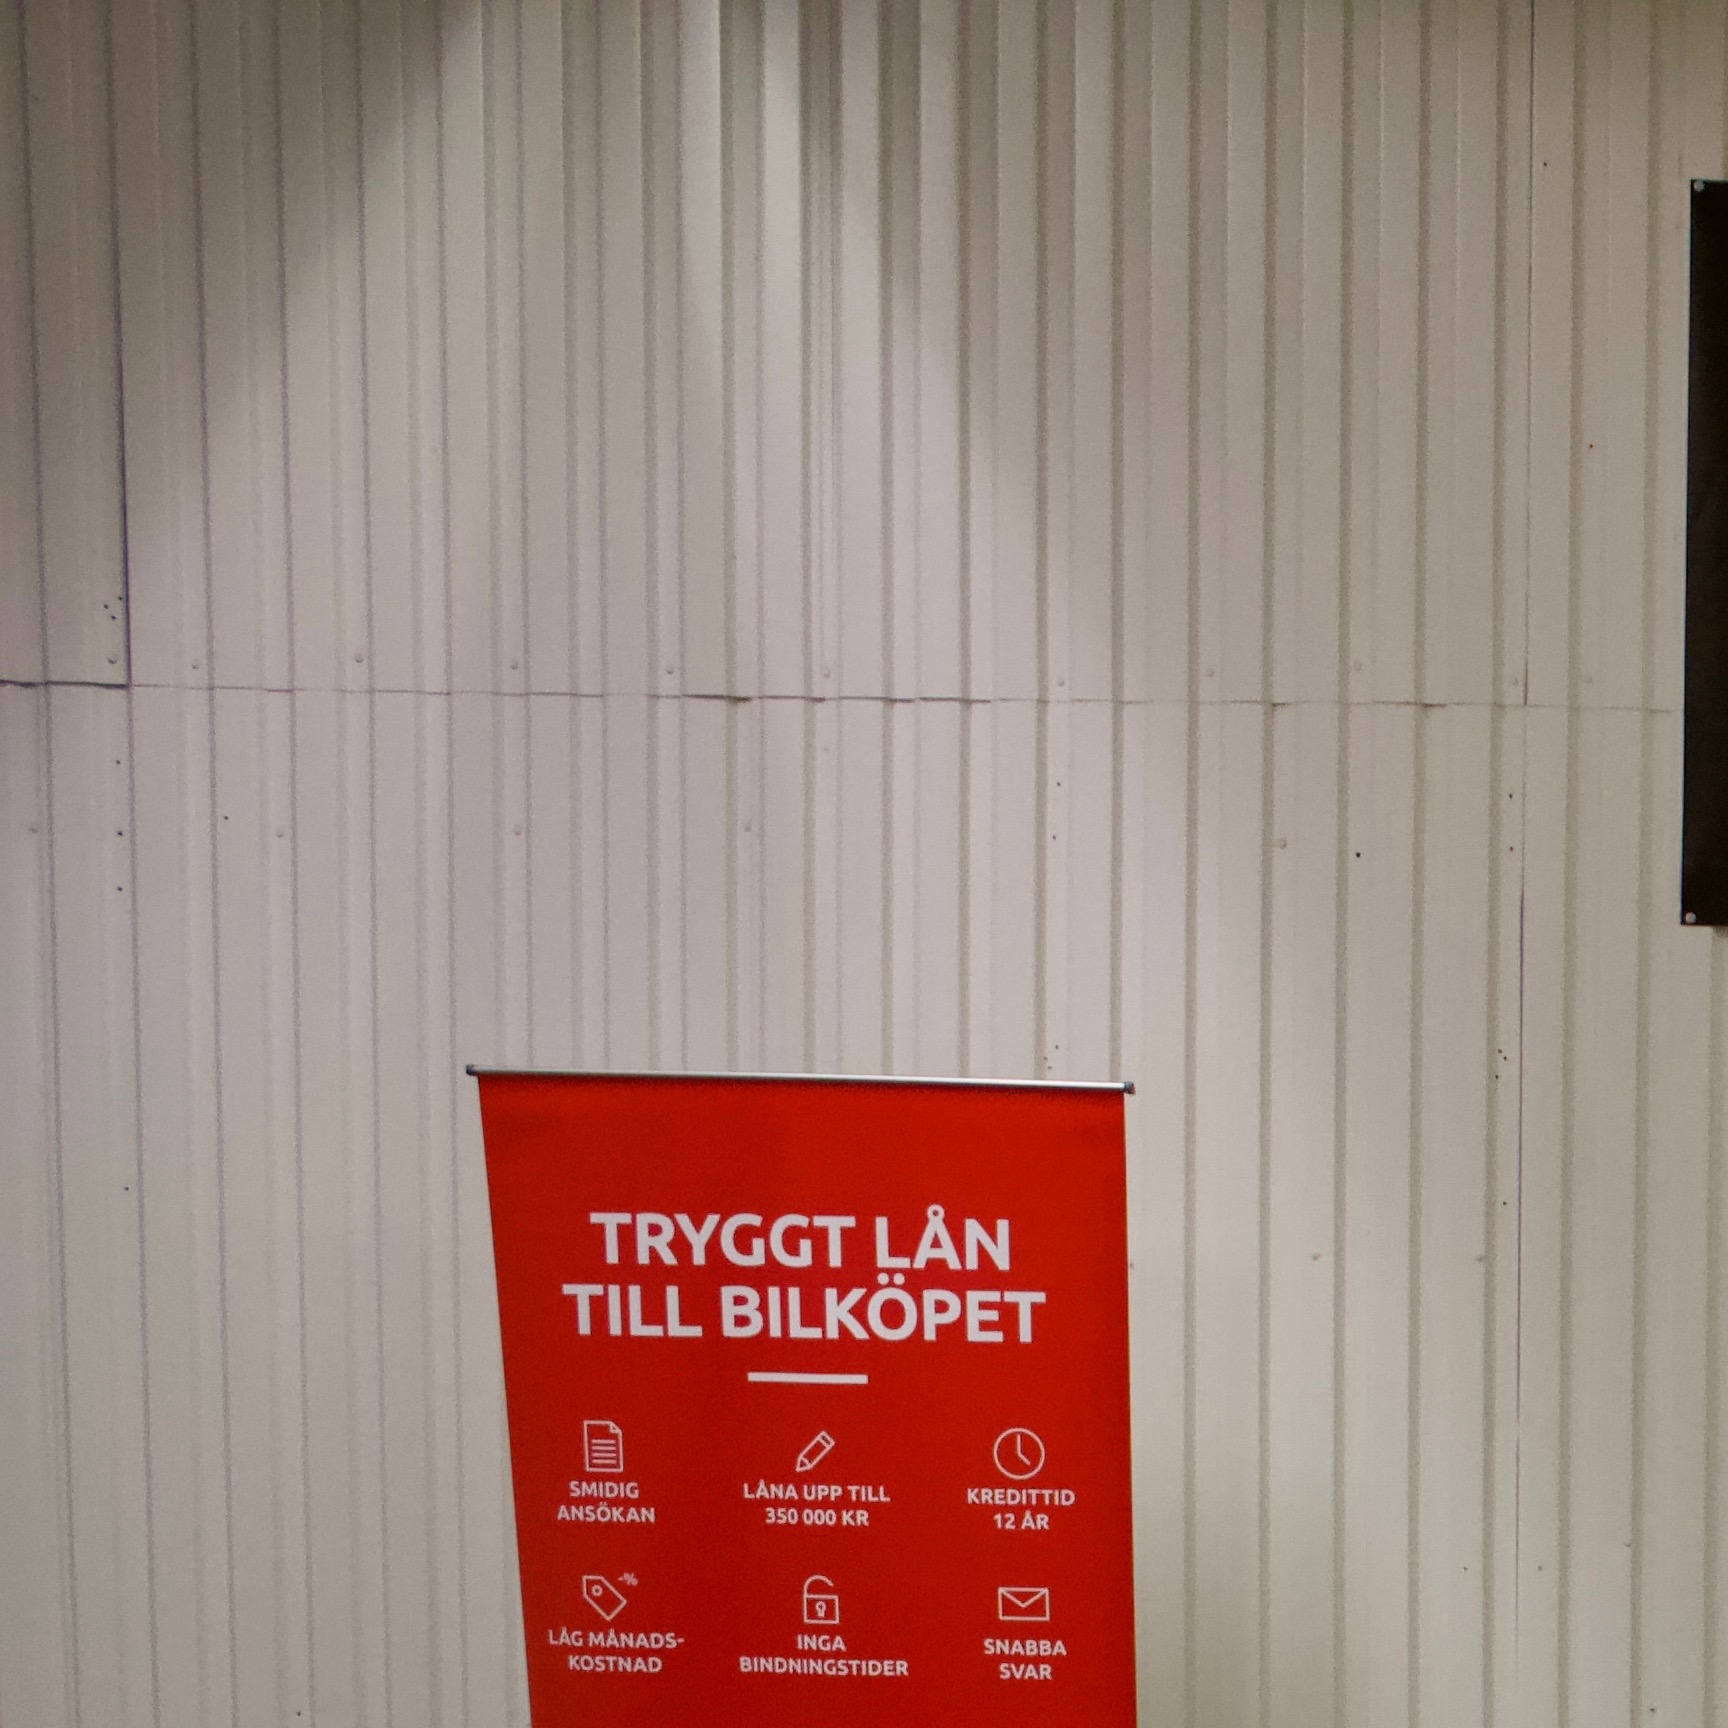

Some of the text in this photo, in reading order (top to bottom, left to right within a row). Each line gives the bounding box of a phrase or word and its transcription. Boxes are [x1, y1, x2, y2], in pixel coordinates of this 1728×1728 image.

[589, 1203, 1011, 1272] TRYGGT LÅN
[561, 1272, 1047, 1343] TILL BILKÖPET
[569, 1480, 640, 1499] SMIDIG
[743, 1479, 891, 1503] LÅNA UPP TILL
[967, 1487, 1076, 1507] KREDITTID
[557, 1501, 656, 1524] ANSÖKAN
[765, 1506, 869, 1527] 350 000 KR
[993, 1509, 1050, 1531] 12 ÅR
[548, 1628, 685, 1649] LÅG MÅNADS-
[796, 1633, 847, 1652] INGA
[983, 1638, 1067, 1657] SNABBA
[568, 1654, 663, 1673] KOSTNAD
[739, 1656, 909, 1677] BINDNINGSTIDER
[999, 1662, 1053, 1680] SVAR
